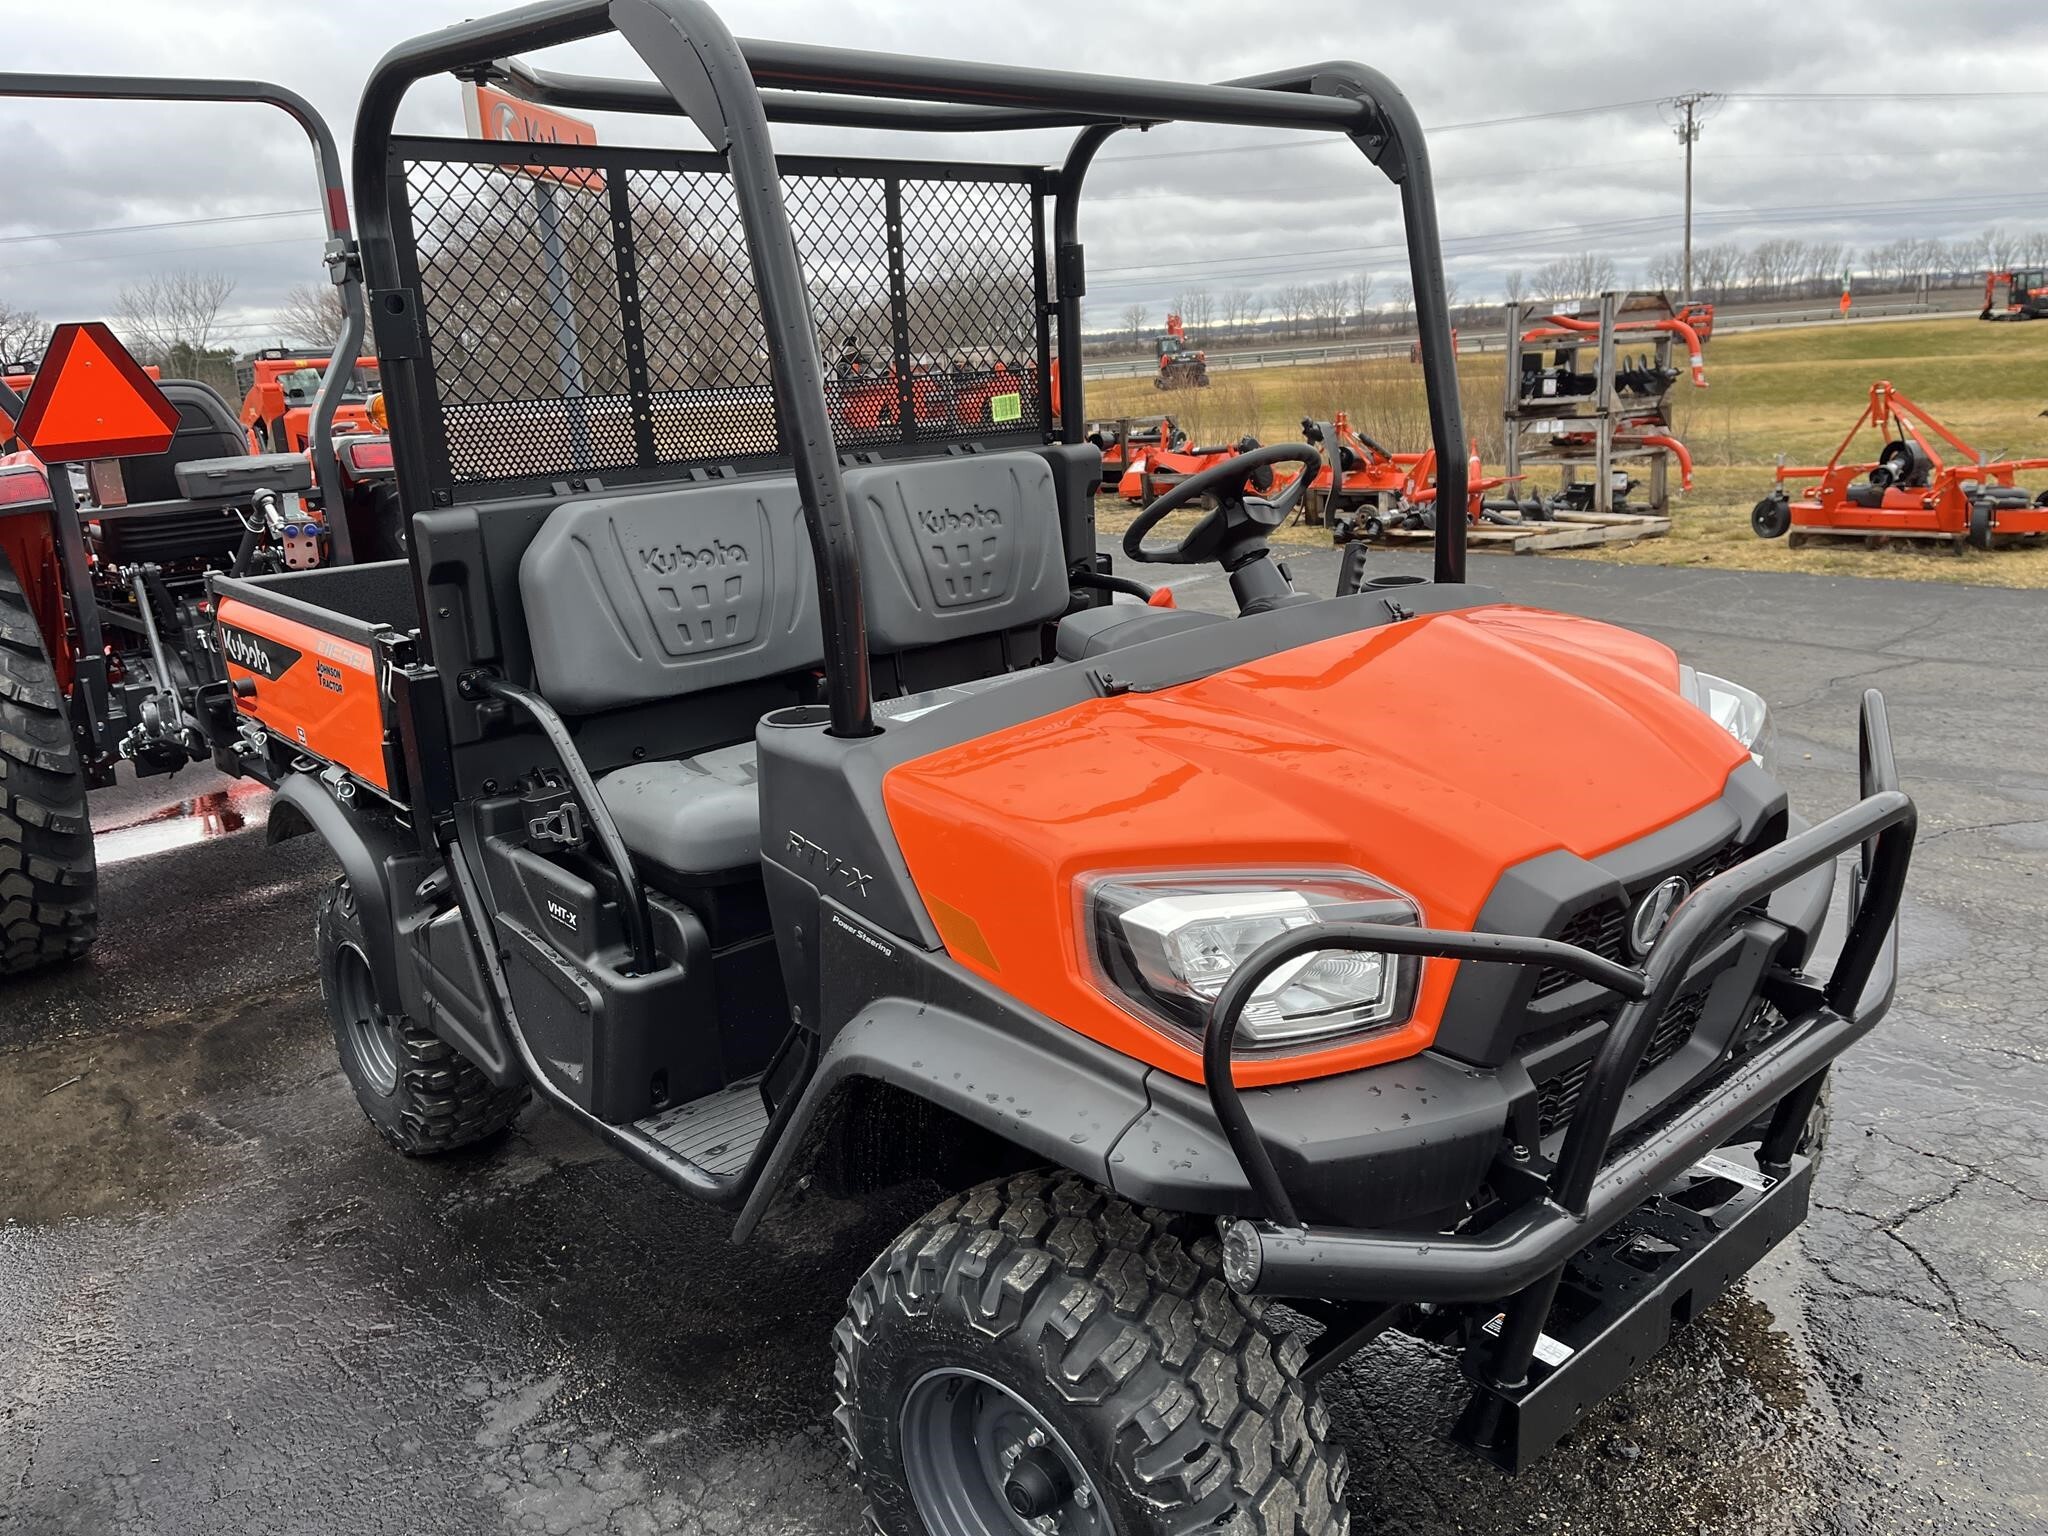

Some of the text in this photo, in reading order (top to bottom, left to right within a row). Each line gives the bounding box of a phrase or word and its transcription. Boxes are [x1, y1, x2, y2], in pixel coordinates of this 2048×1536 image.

[918, 504, 1002, 535] Kubota
[638, 539, 749, 575] Kubota
[221, 627, 272, 675] Kubota
[786, 829, 874, 898] RTV-X
[547, 900, 577, 926] VHT-X
[832, 914, 893, 957] Power Steering
